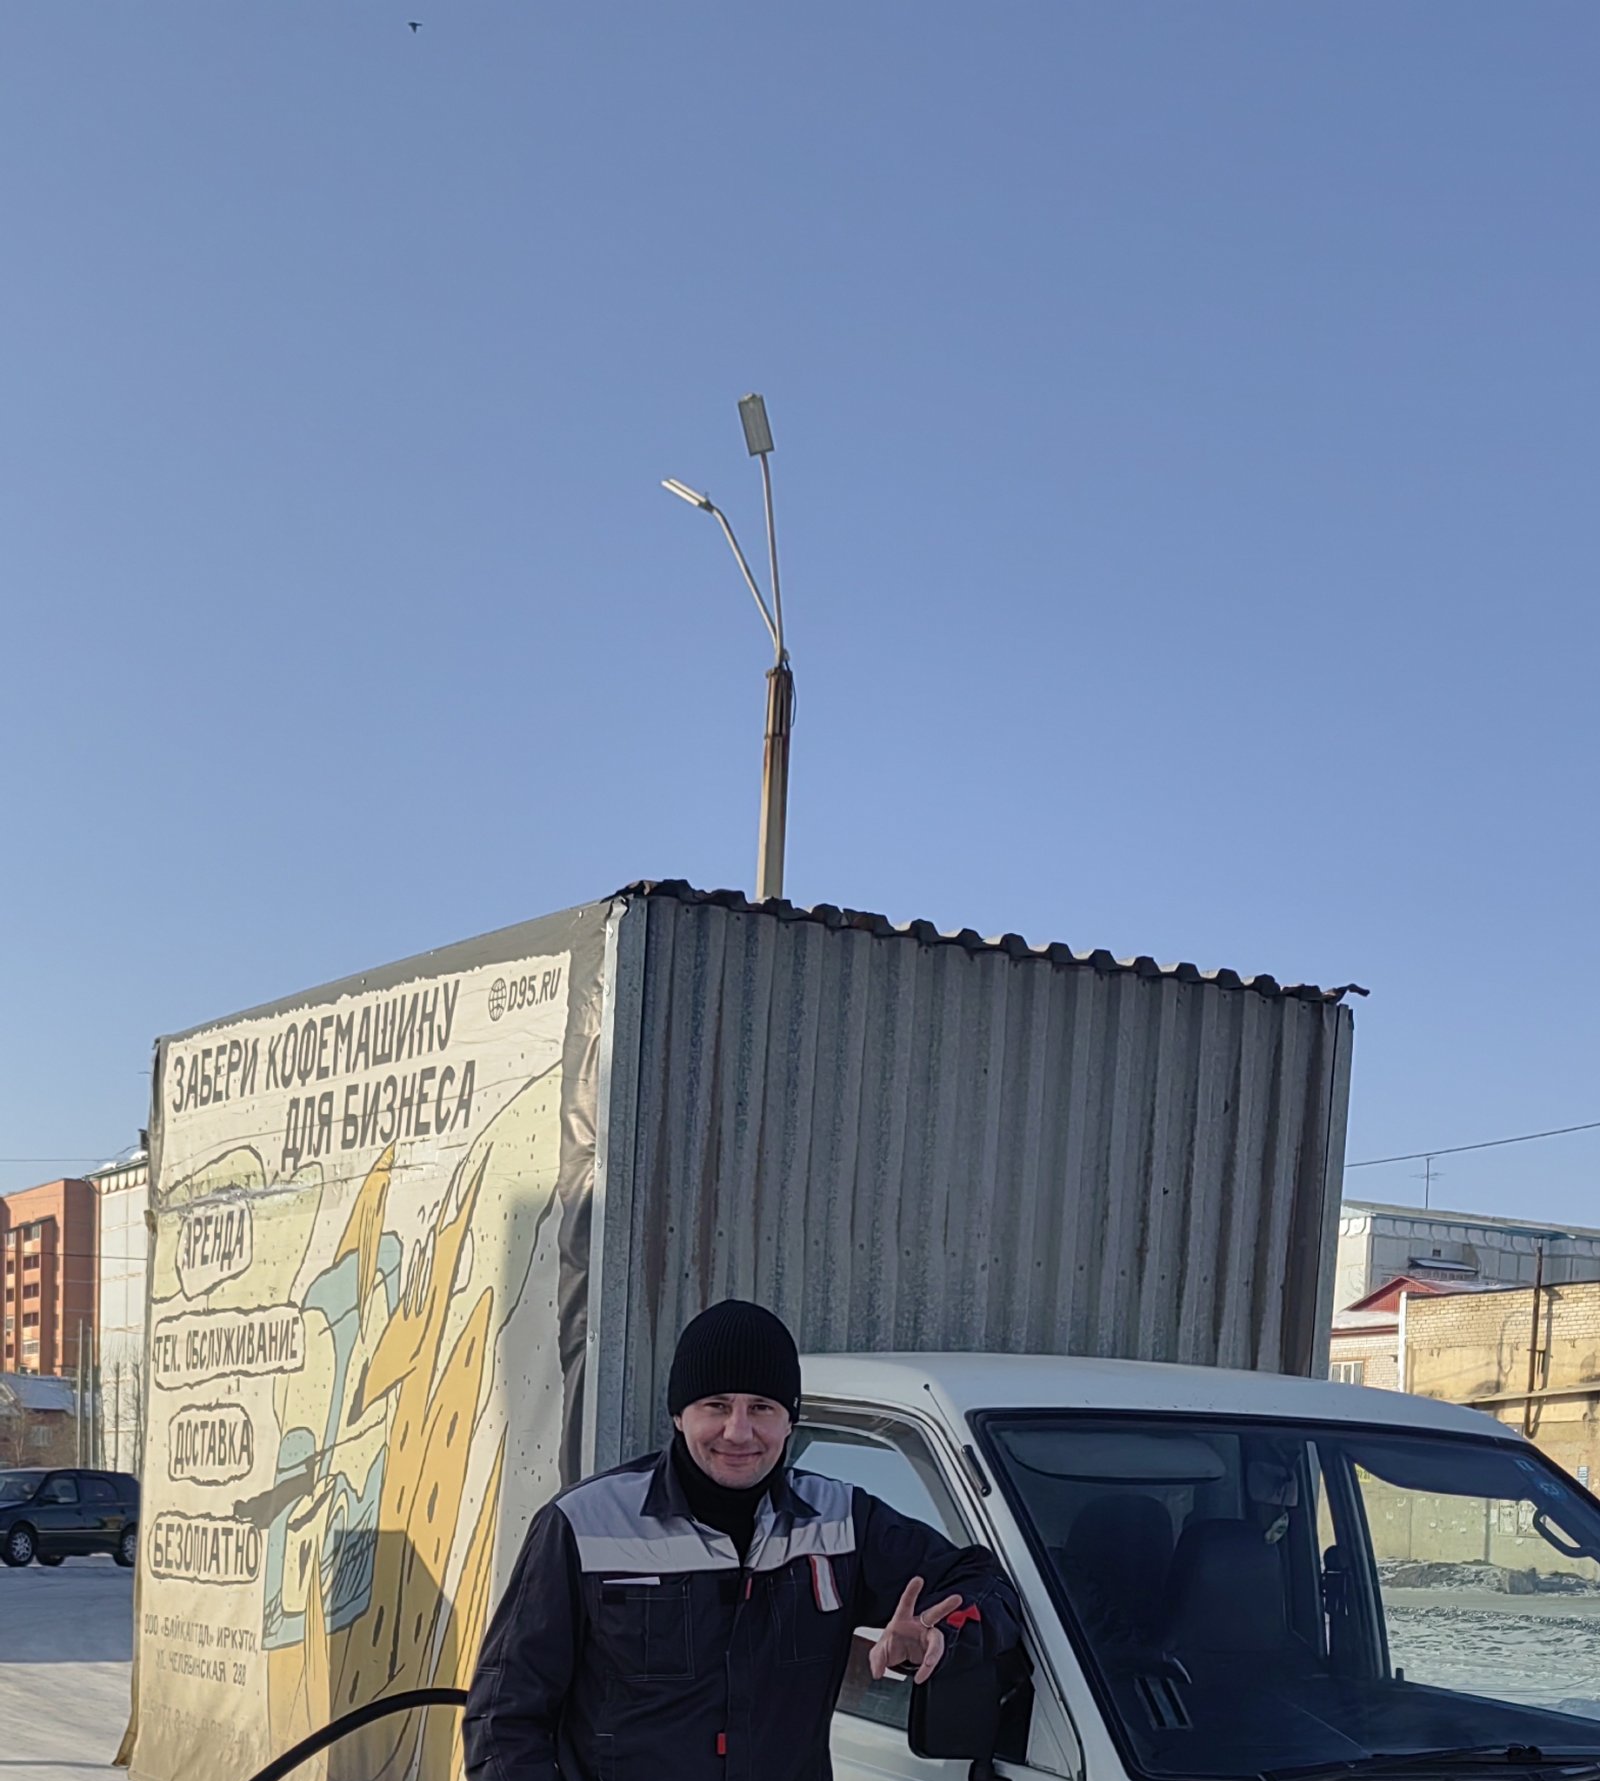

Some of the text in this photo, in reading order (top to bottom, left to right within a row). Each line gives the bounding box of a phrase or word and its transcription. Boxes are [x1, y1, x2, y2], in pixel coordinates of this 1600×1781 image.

[507, 967, 561, 1012] D95.RU
[172, 980, 461, 1113] ЗАБЕРИ КОФЕМАШИНУ
[281, 1060, 475, 1172] ДЛЯ БИЗНЕСА
[182, 1209, 246, 1272] АРЕНДА
[155, 1316, 299, 1374] ТЕХ. ОБСЛУЖИВАНИЕ
[174, 1418, 252, 1475] ДОСТАВКА
[154, 1525, 259, 1577] БЕЗОПЛАТНО
[144, 1614, 158, 1636] ООО
